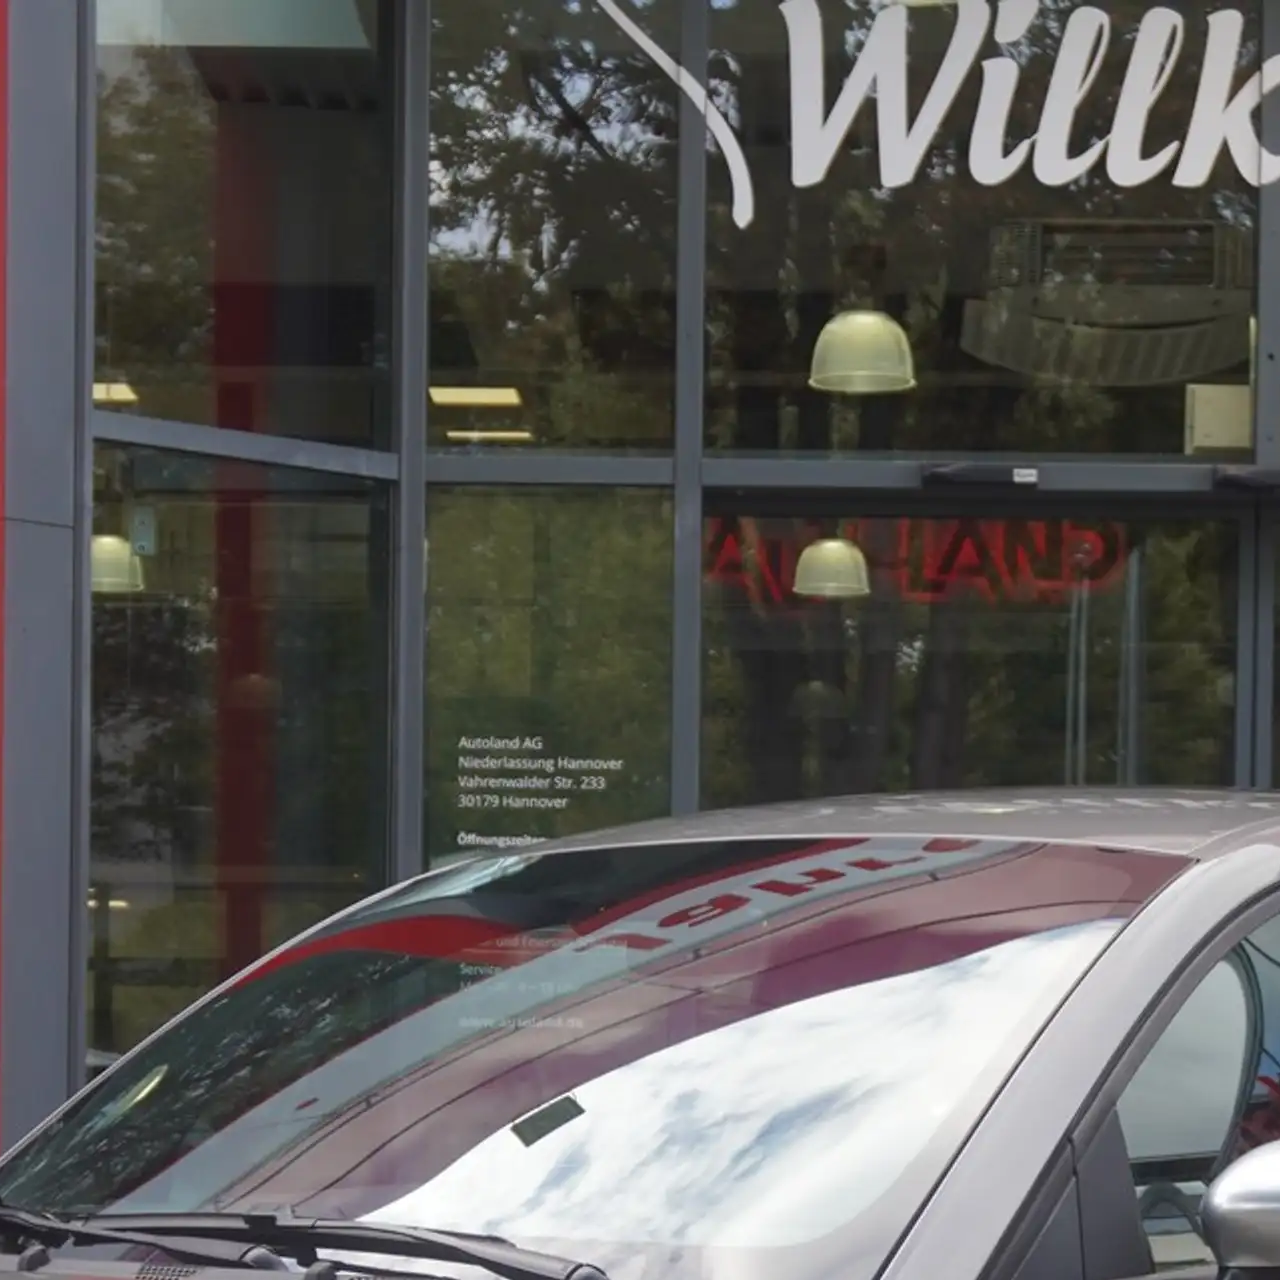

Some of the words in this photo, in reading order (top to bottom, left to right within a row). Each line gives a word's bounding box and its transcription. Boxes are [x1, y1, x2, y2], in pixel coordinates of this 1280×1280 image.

[458, 736, 519, 749] Autoland
[522, 737, 543, 749] AG
[458, 756, 555, 772] Niederlassung
[557, 757, 623, 770] Hannover
[458, 776, 550, 789] Vahrenwalder
[554, 776, 577, 789] Str.
[580, 776, 605, 789] 233
[458, 794, 500, 808] 30179
[502, 795, 568, 808] Hannover
